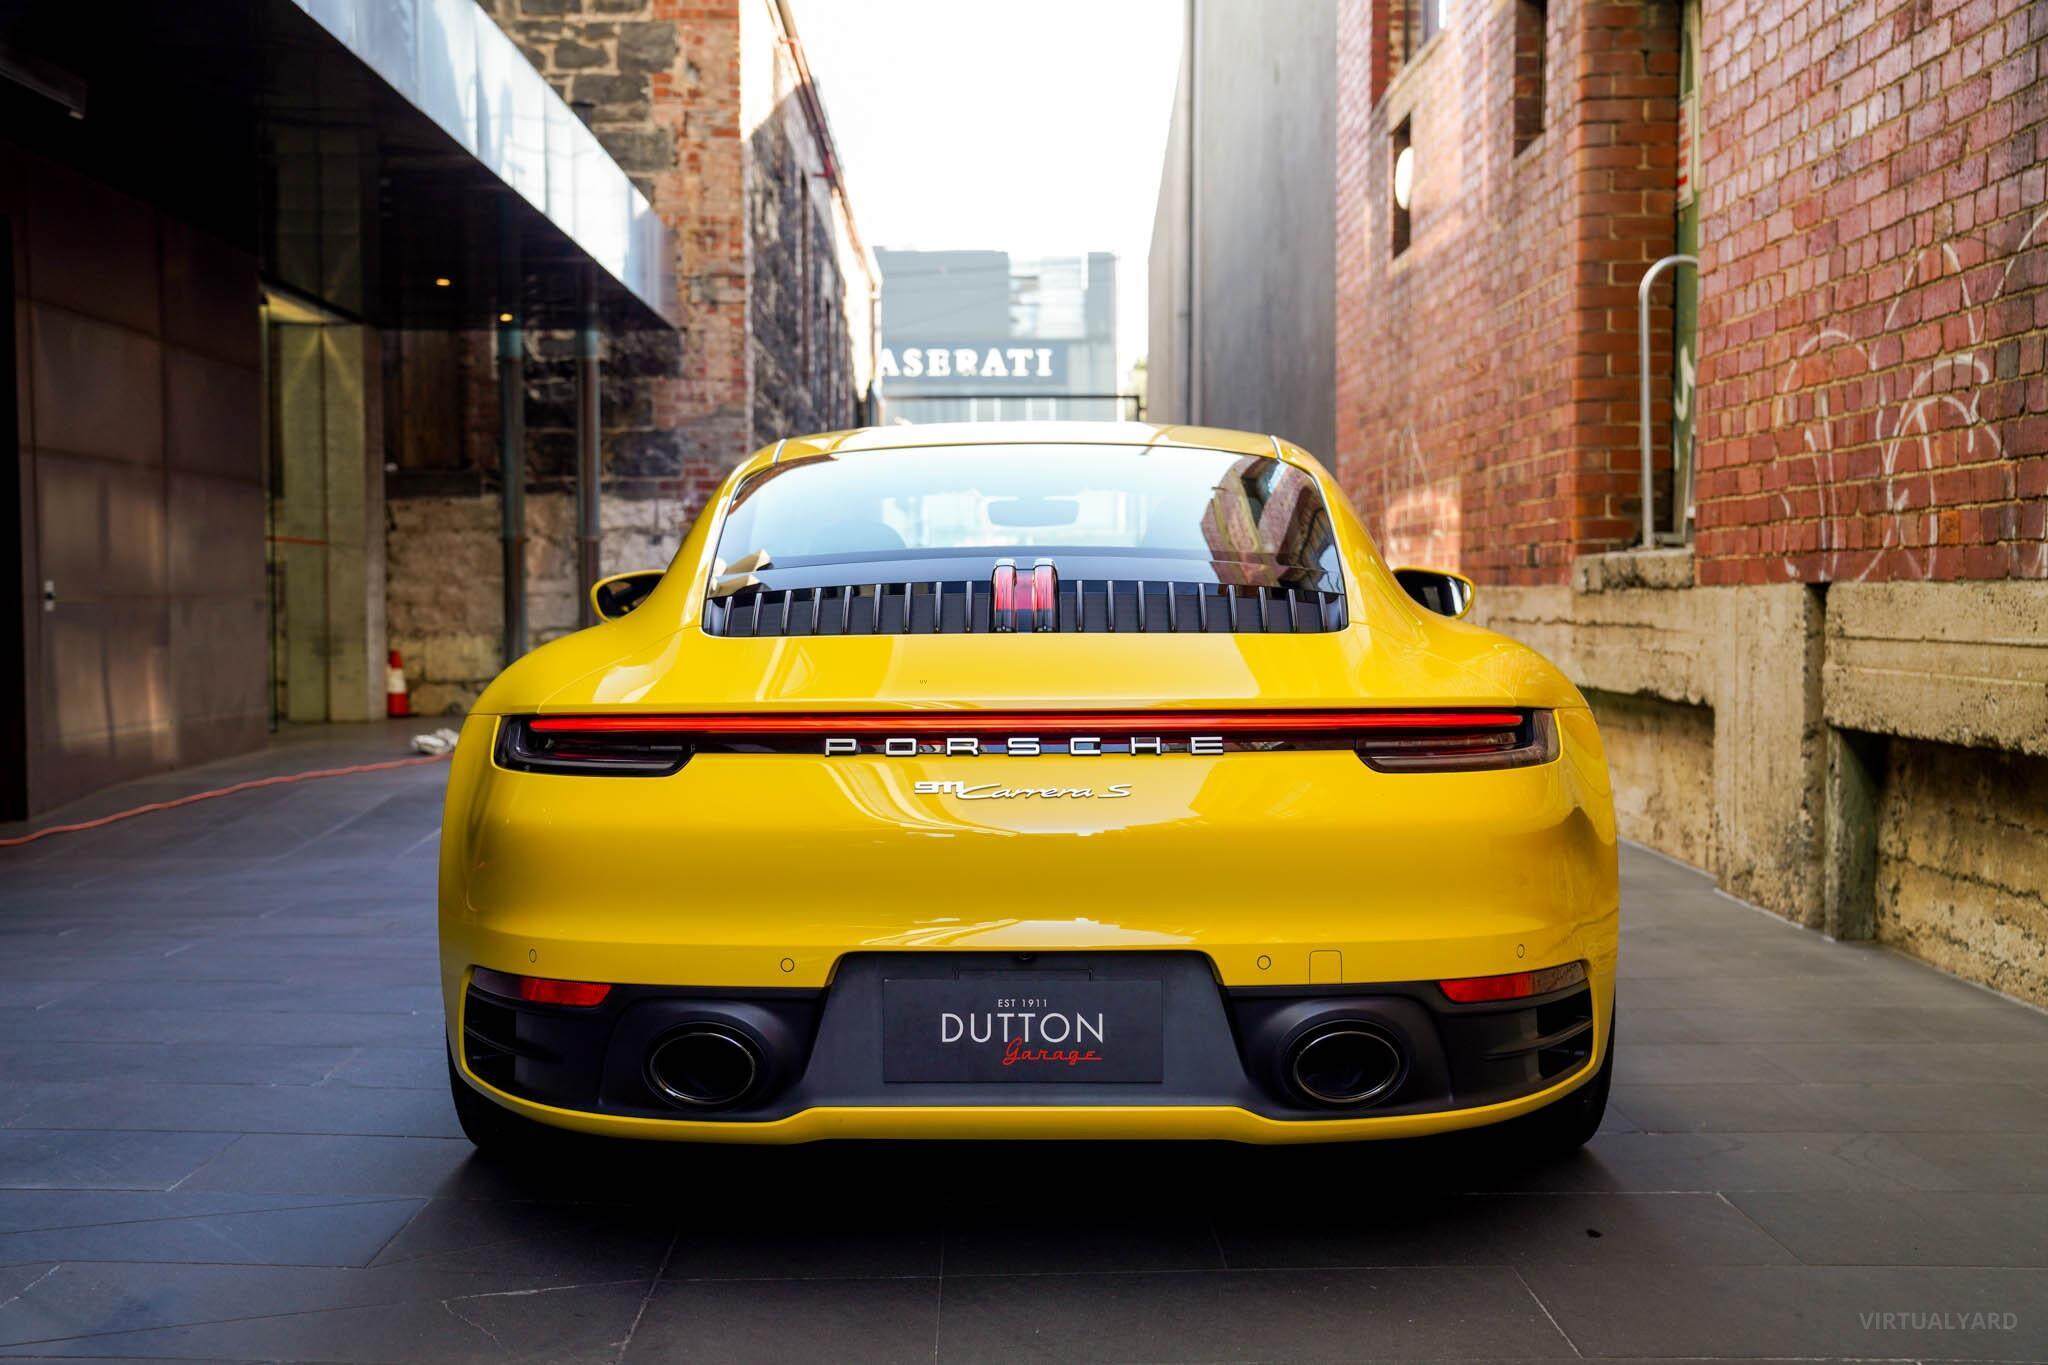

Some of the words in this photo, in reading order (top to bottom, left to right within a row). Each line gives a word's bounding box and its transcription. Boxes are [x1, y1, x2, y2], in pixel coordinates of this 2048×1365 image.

[825, 736, 1224, 756] PORSCHE
[914, 781, 964, 794] 911
[956, 784, 1094, 799] Carrera
[1097, 784, 1132, 798] S
[997, 999, 1015, 1007] EST
[1021, 999, 1048, 1007] 1911
[941, 1013, 1104, 1044] DUTTON
[1002, 1035, 1103, 1066] Garage
